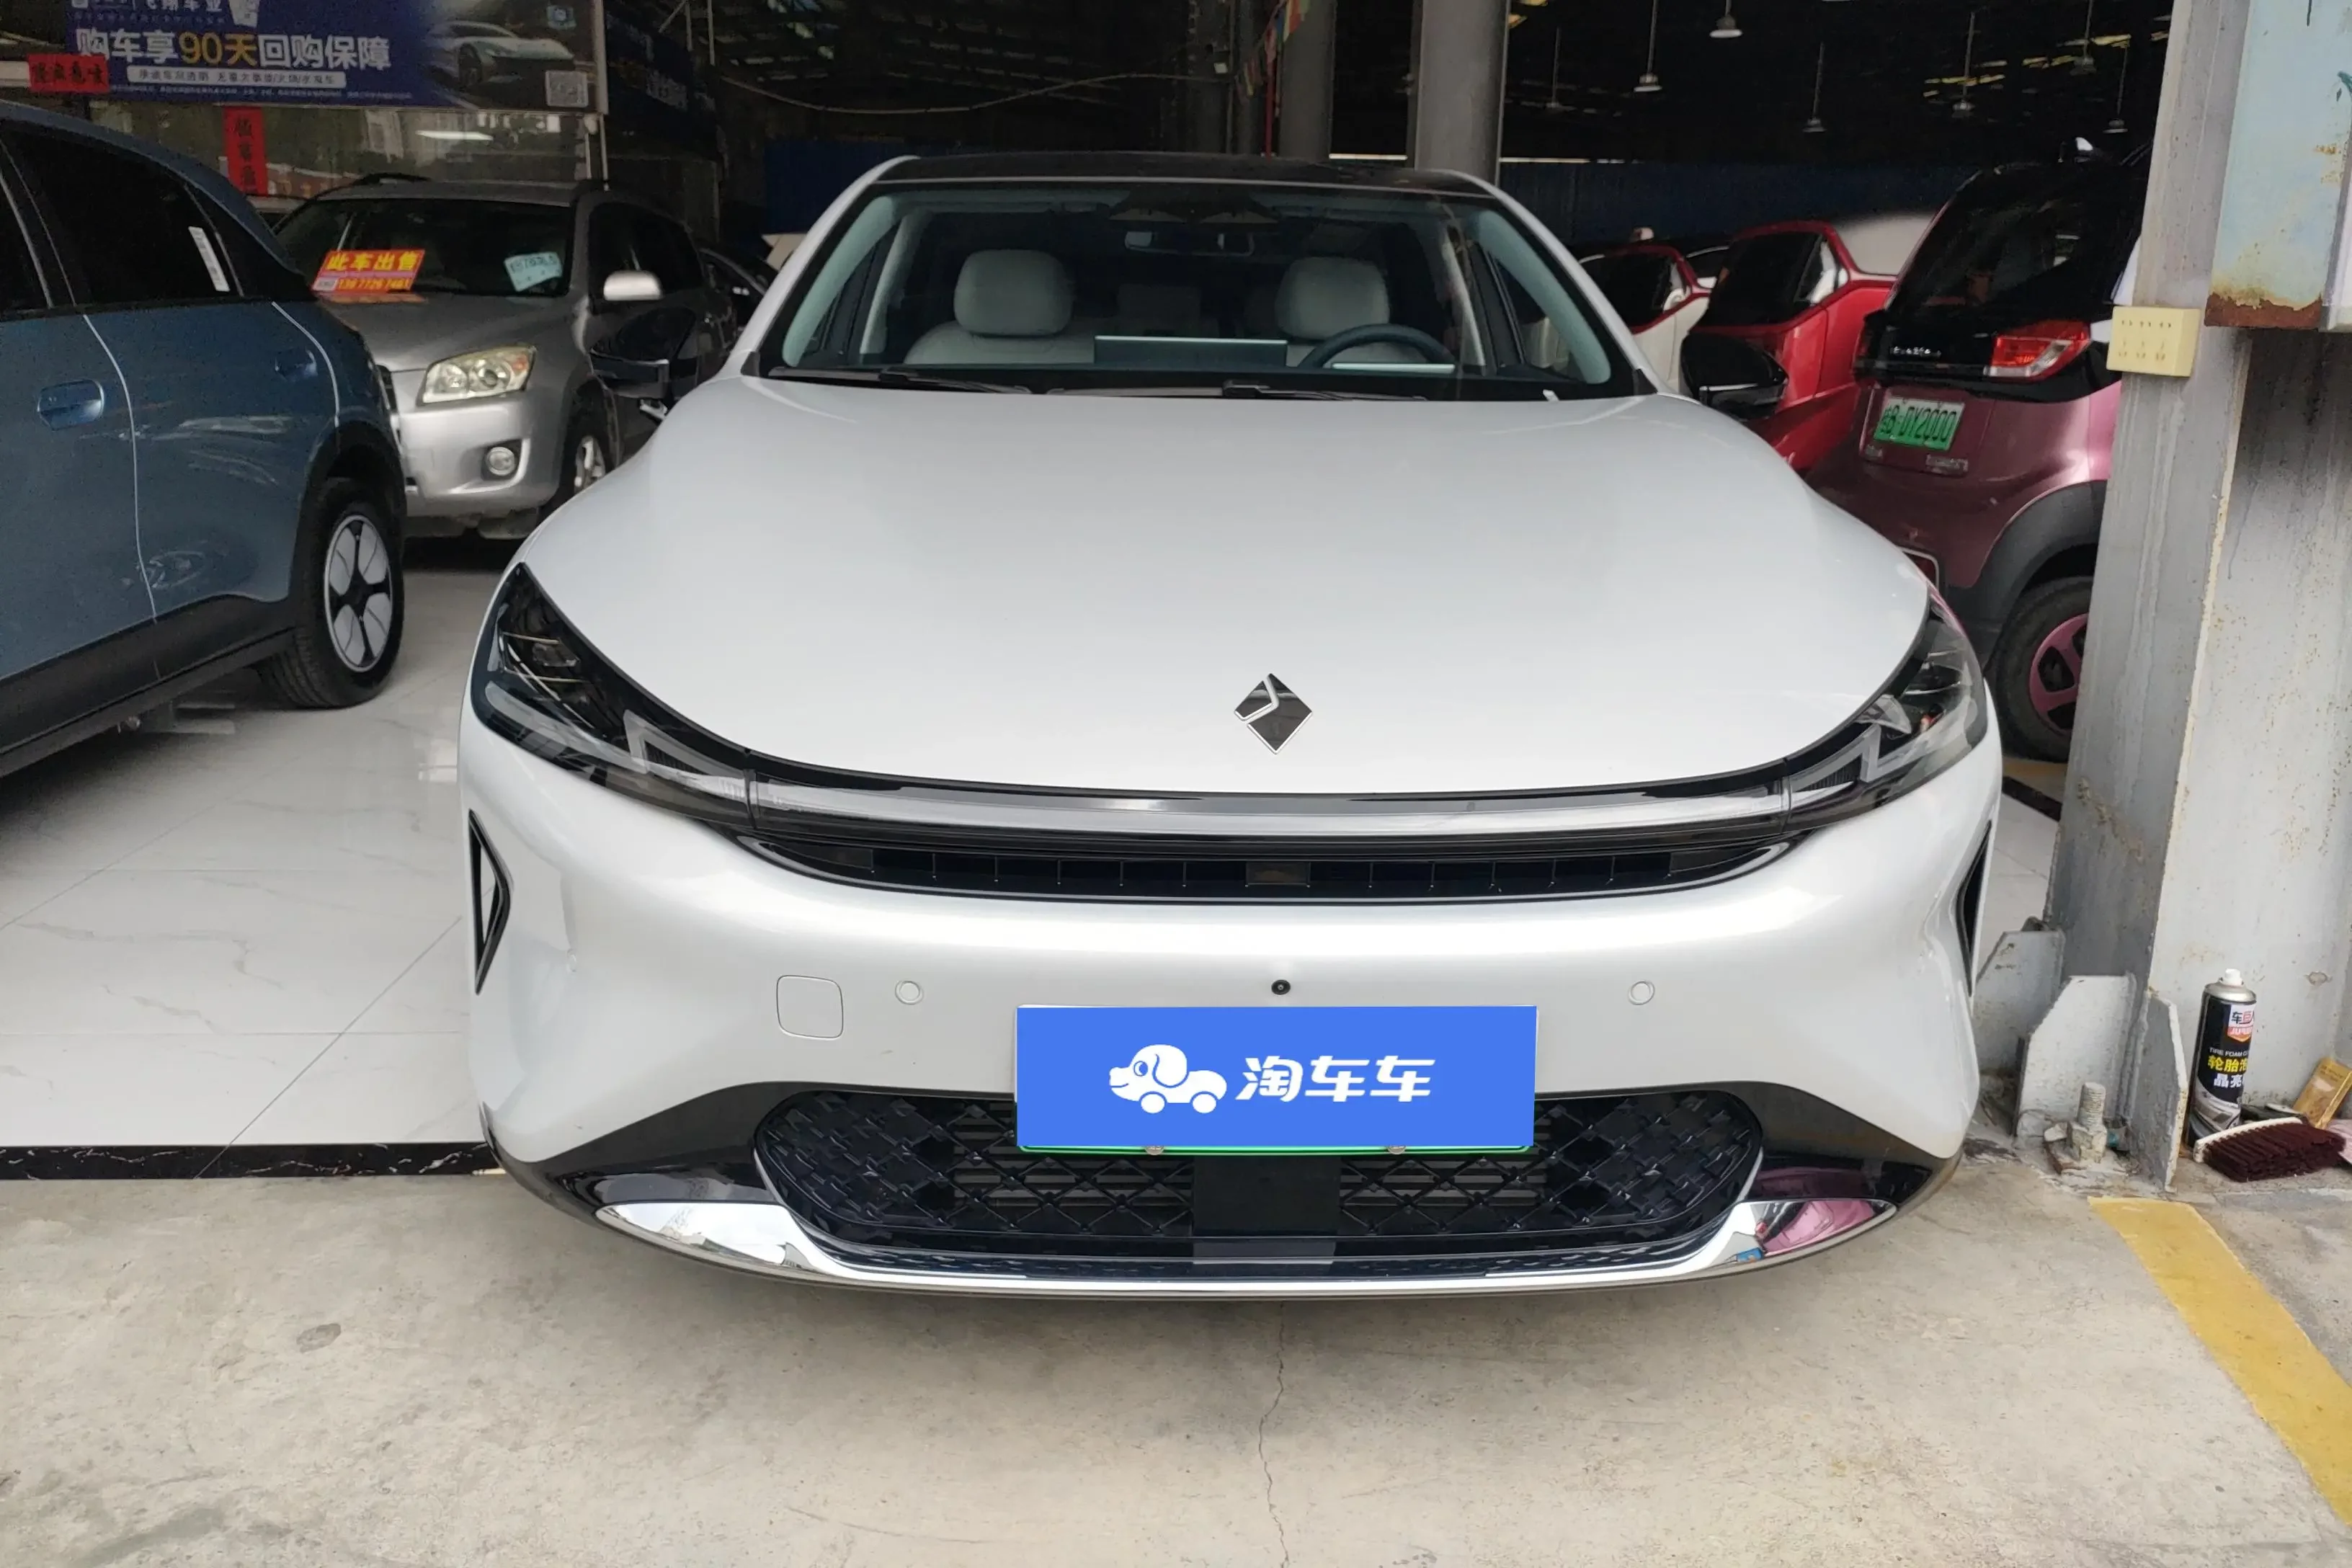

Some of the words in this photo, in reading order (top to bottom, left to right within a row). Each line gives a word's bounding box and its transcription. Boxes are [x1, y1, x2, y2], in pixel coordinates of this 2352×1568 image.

[76, 27, 391, 71] 购车享90天回购保障
[326, 250, 419, 272] 此车出售
